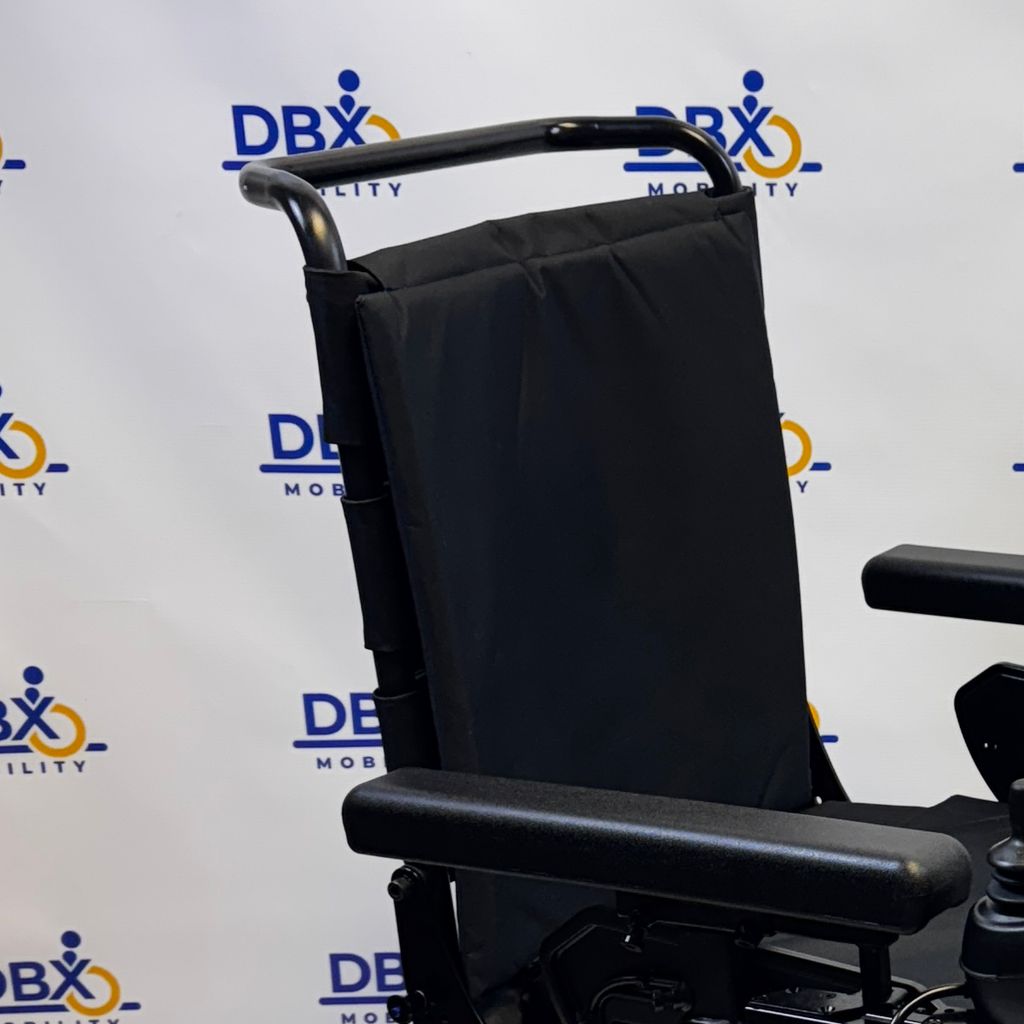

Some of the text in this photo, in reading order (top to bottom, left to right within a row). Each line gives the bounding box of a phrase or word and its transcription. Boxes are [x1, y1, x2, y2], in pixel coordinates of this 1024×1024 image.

[232, 105, 371, 156] DBX
[321, 183, 402, 197] ILITY
[648, 183, 798, 197] MOBITY
[302, 692, 381, 736] DB
[7, 760, 86, 775] ILITY
[0, 959, 96, 1002] BX
[329, 952, 407, 993] DB
